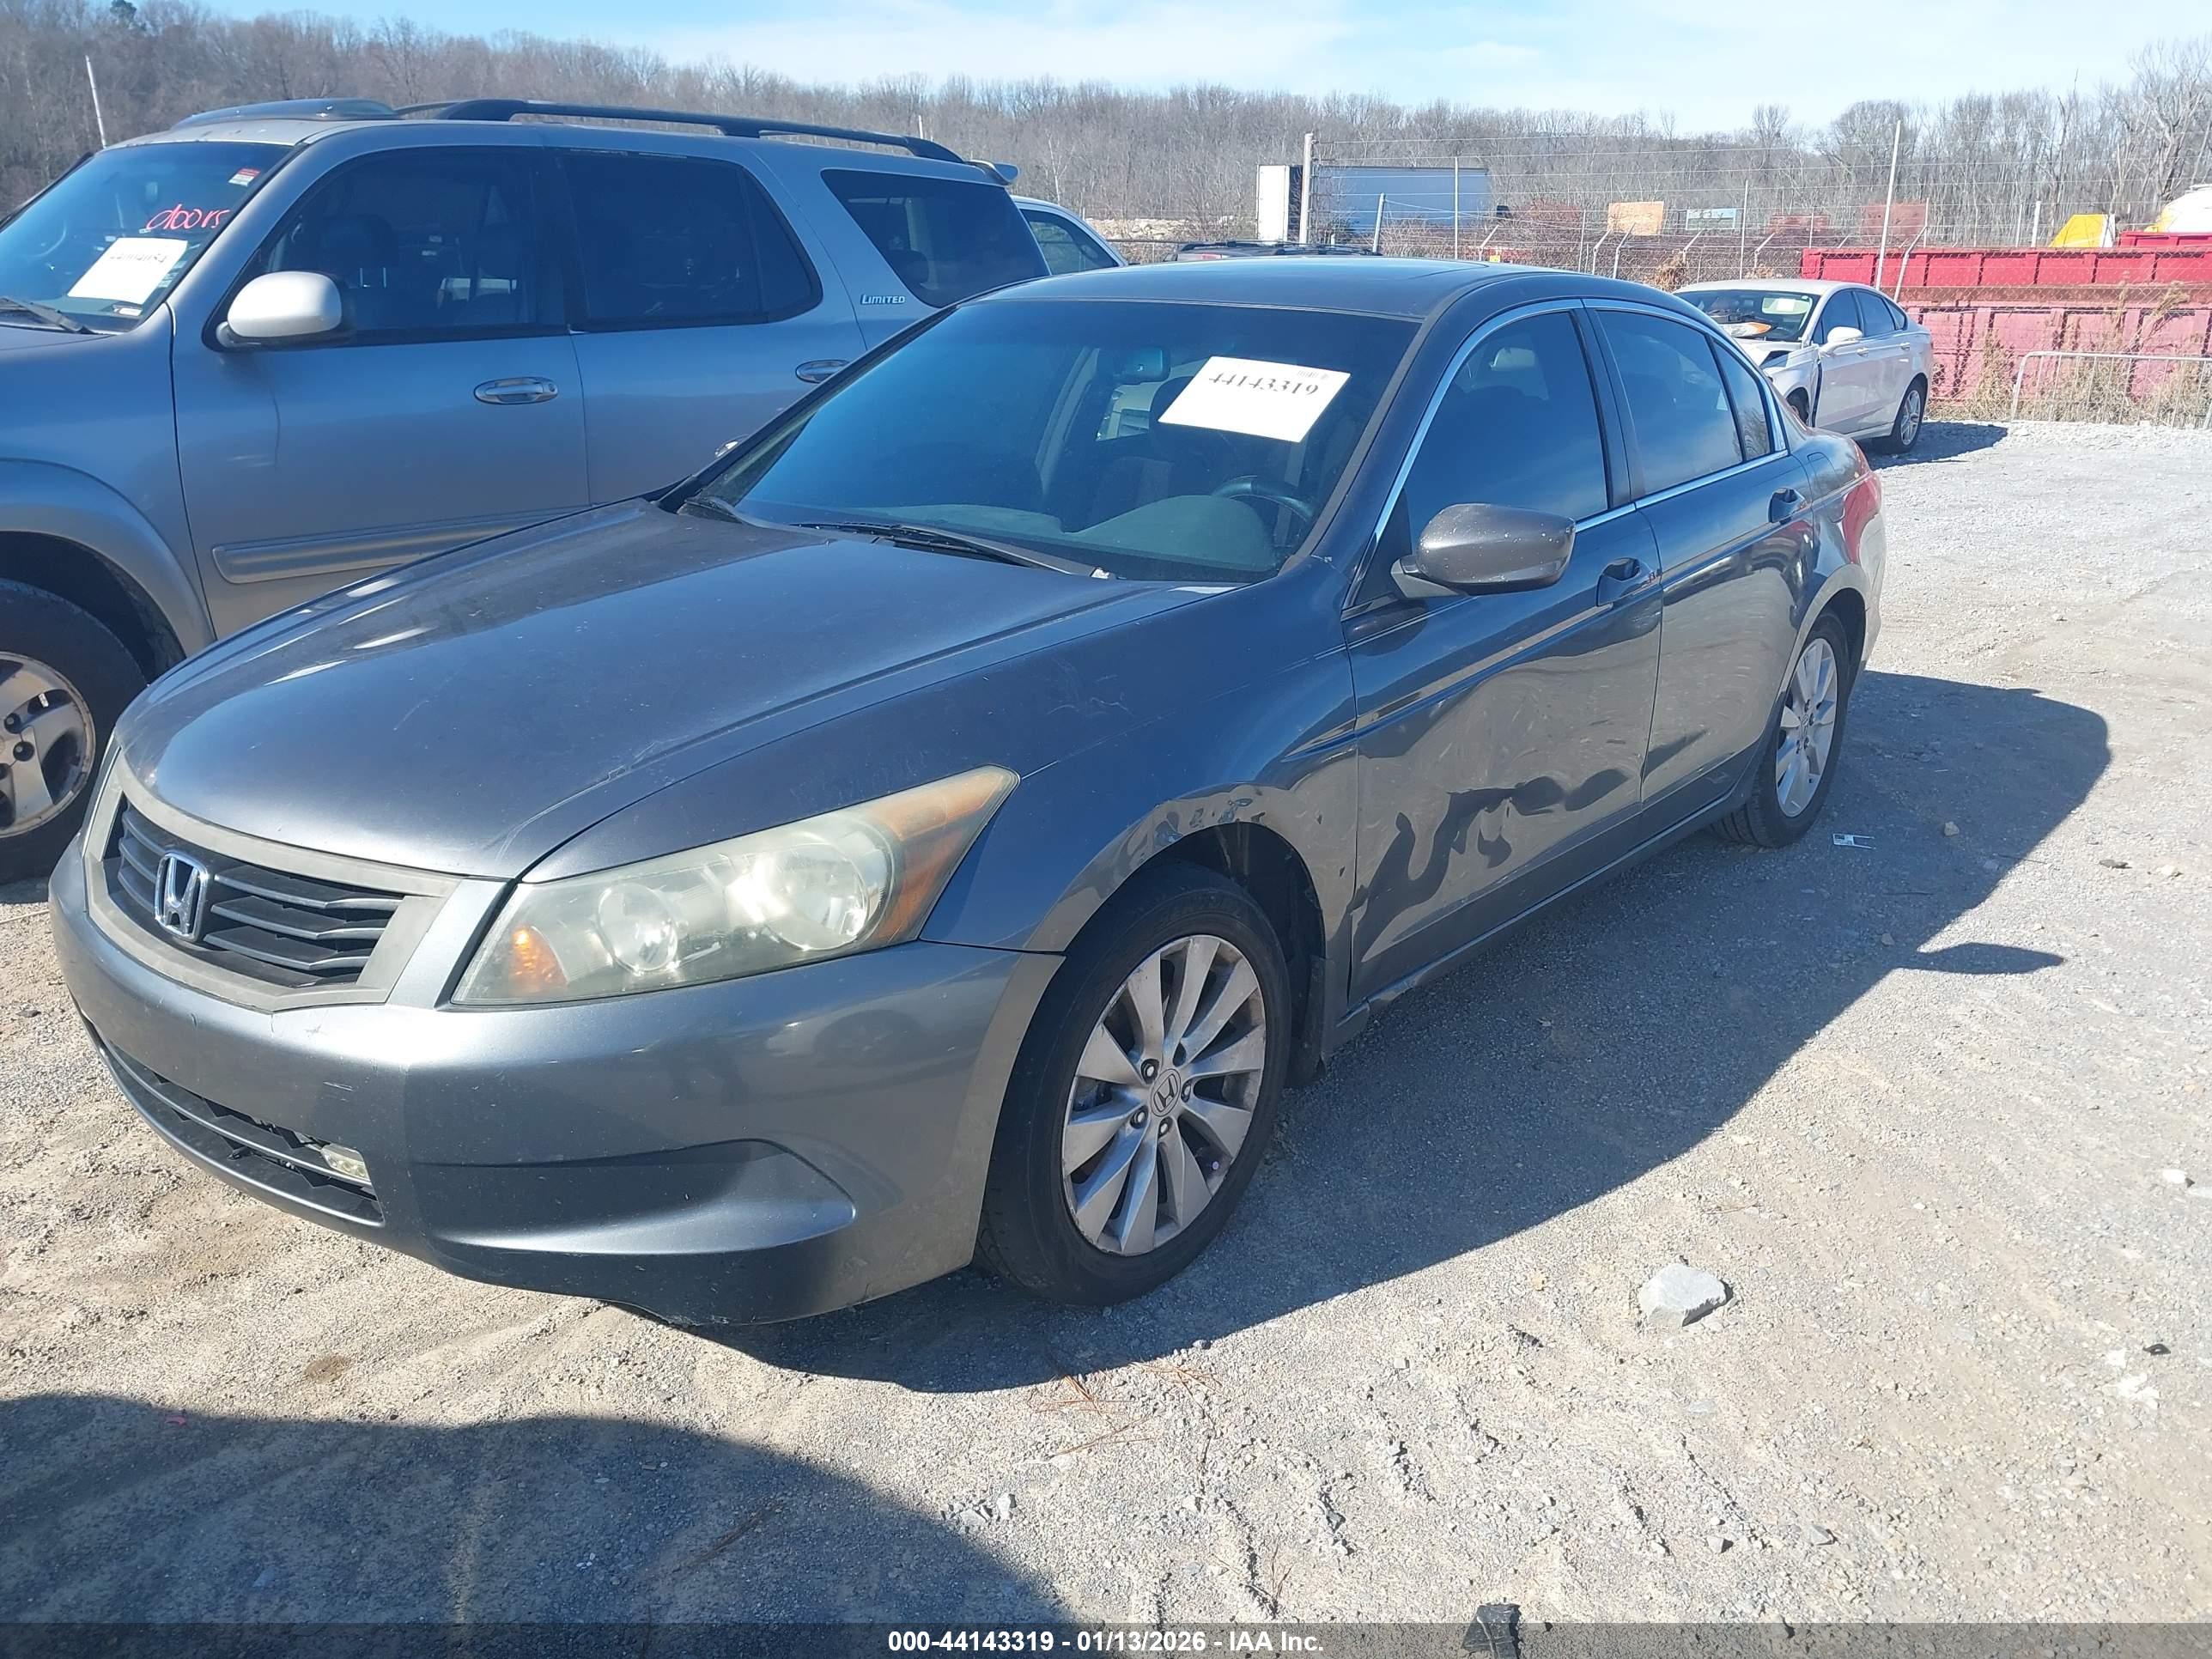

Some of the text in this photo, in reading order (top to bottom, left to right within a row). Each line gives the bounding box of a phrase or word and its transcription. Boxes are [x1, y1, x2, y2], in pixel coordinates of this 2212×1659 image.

[145, 204, 230, 230] doors
[860, 294, 906, 306] LIMITED
[1208, 372, 1320, 396] 44143319
